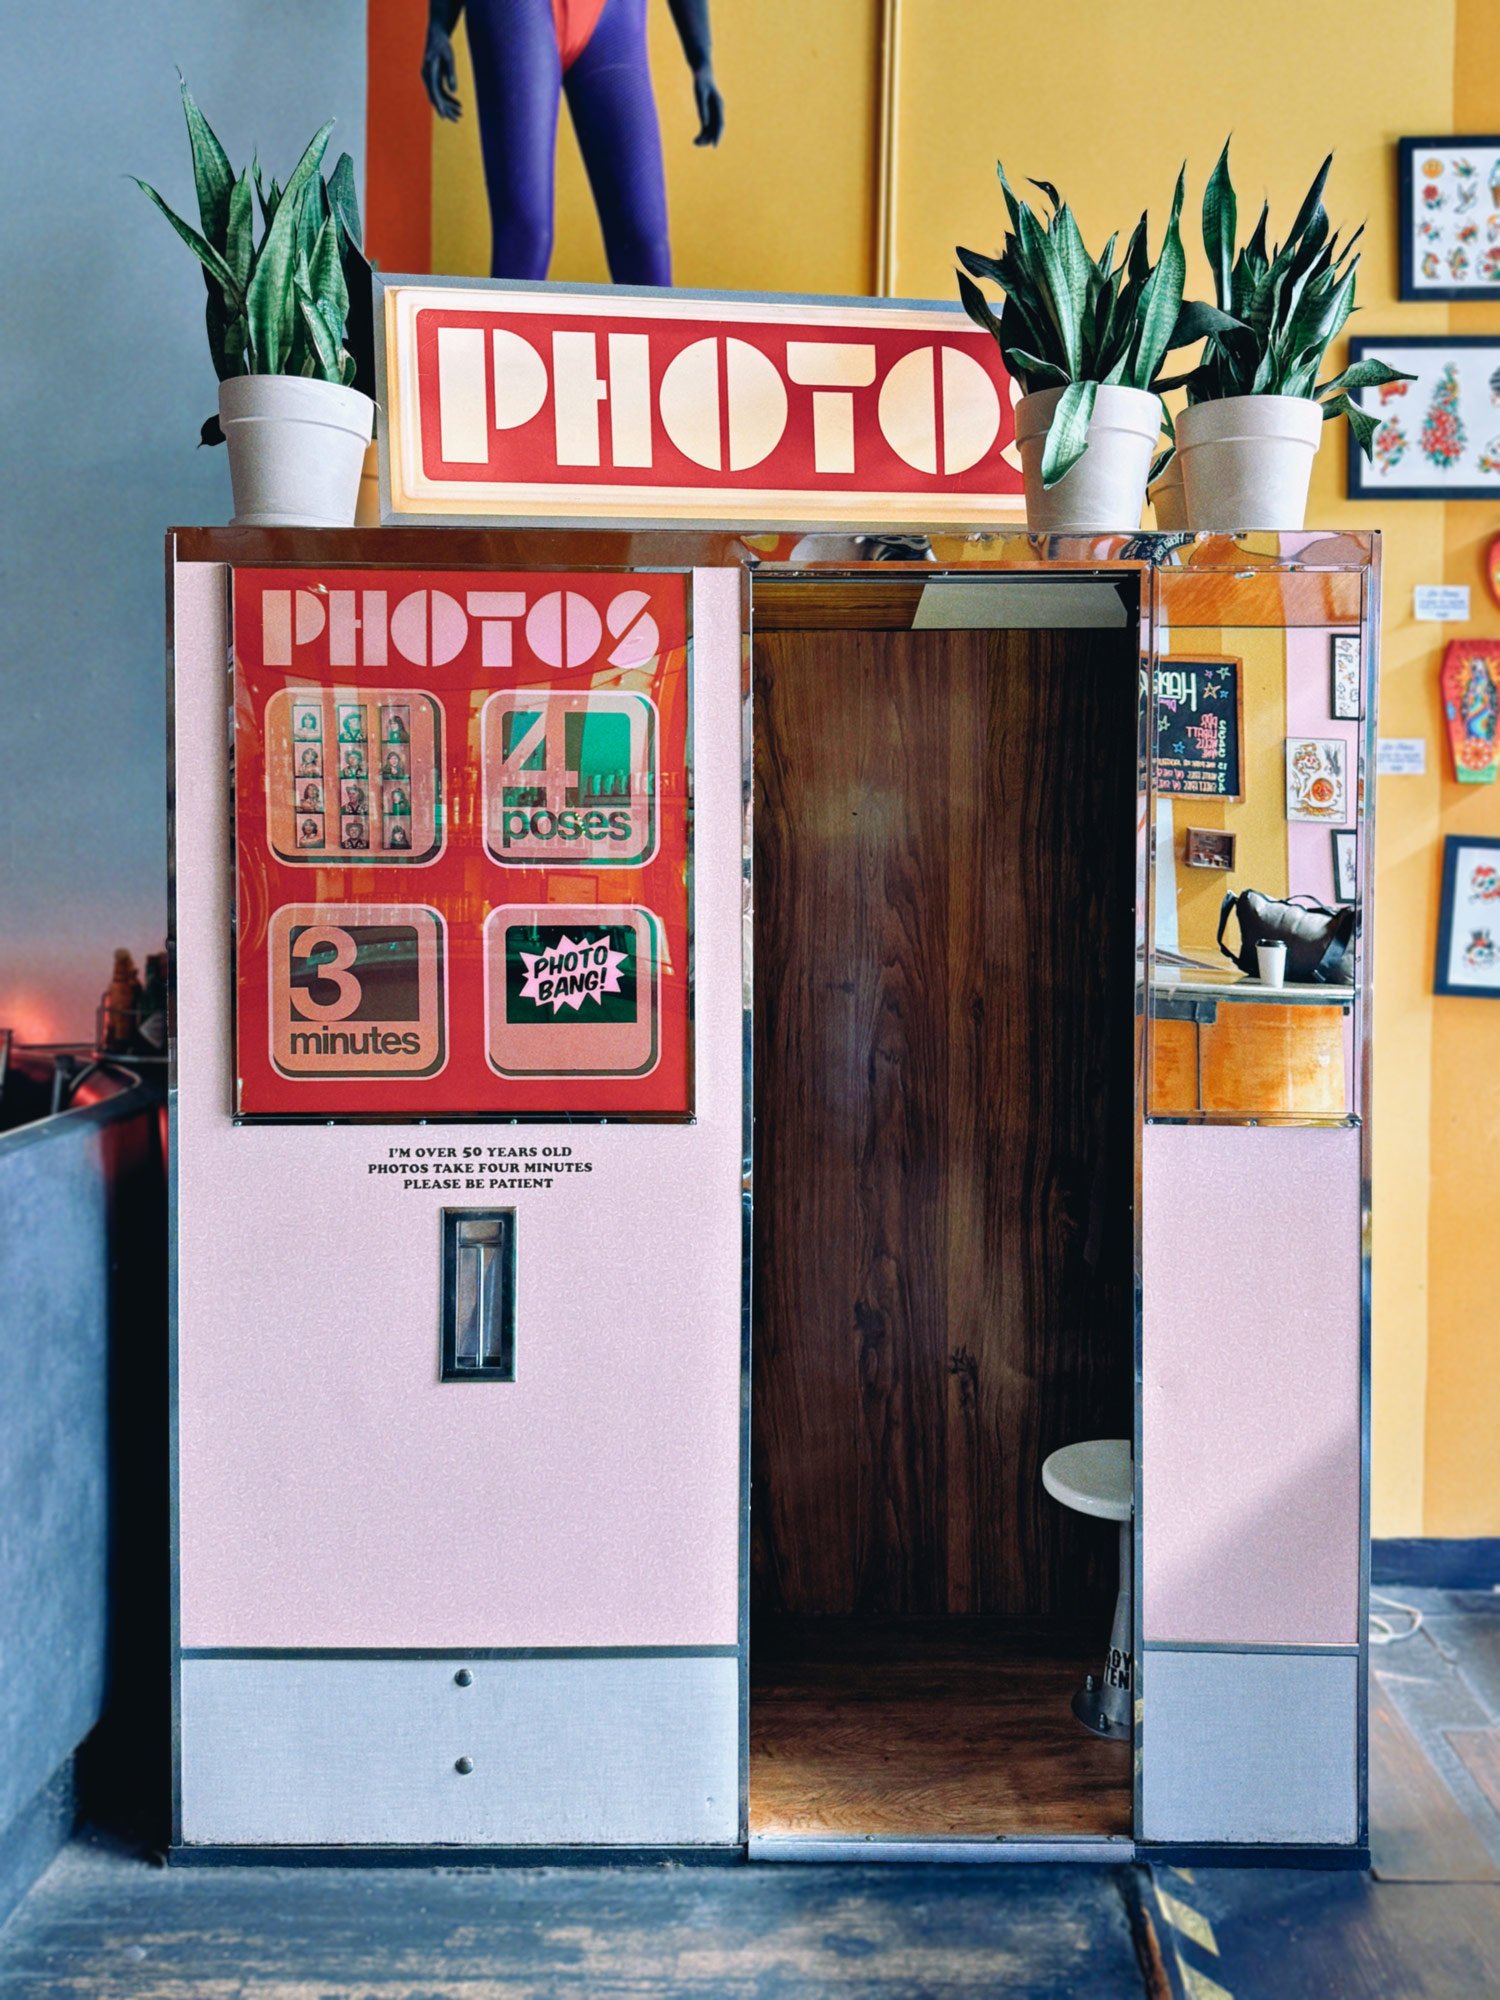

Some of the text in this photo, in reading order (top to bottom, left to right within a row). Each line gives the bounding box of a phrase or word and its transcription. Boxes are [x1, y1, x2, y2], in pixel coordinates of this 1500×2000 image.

[262, 589, 660, 670] PHOTOS
[502, 709, 579, 808] 4
[502, 810, 632, 849] poses
[292, 926, 362, 1021] 3
[533, 945, 608, 979] PHOTO
[538, 966, 607, 1001] BANG!
[290, 1026, 421, 1055] minutes
[368, 1162, 593, 1174] PHOTOS TAKE FOUR MINUTES
[389, 1146, 572, 1158] I'M OVER 50 YEARS OLD
[403, 1178, 554, 1189] PLEASE BE PATIENT
